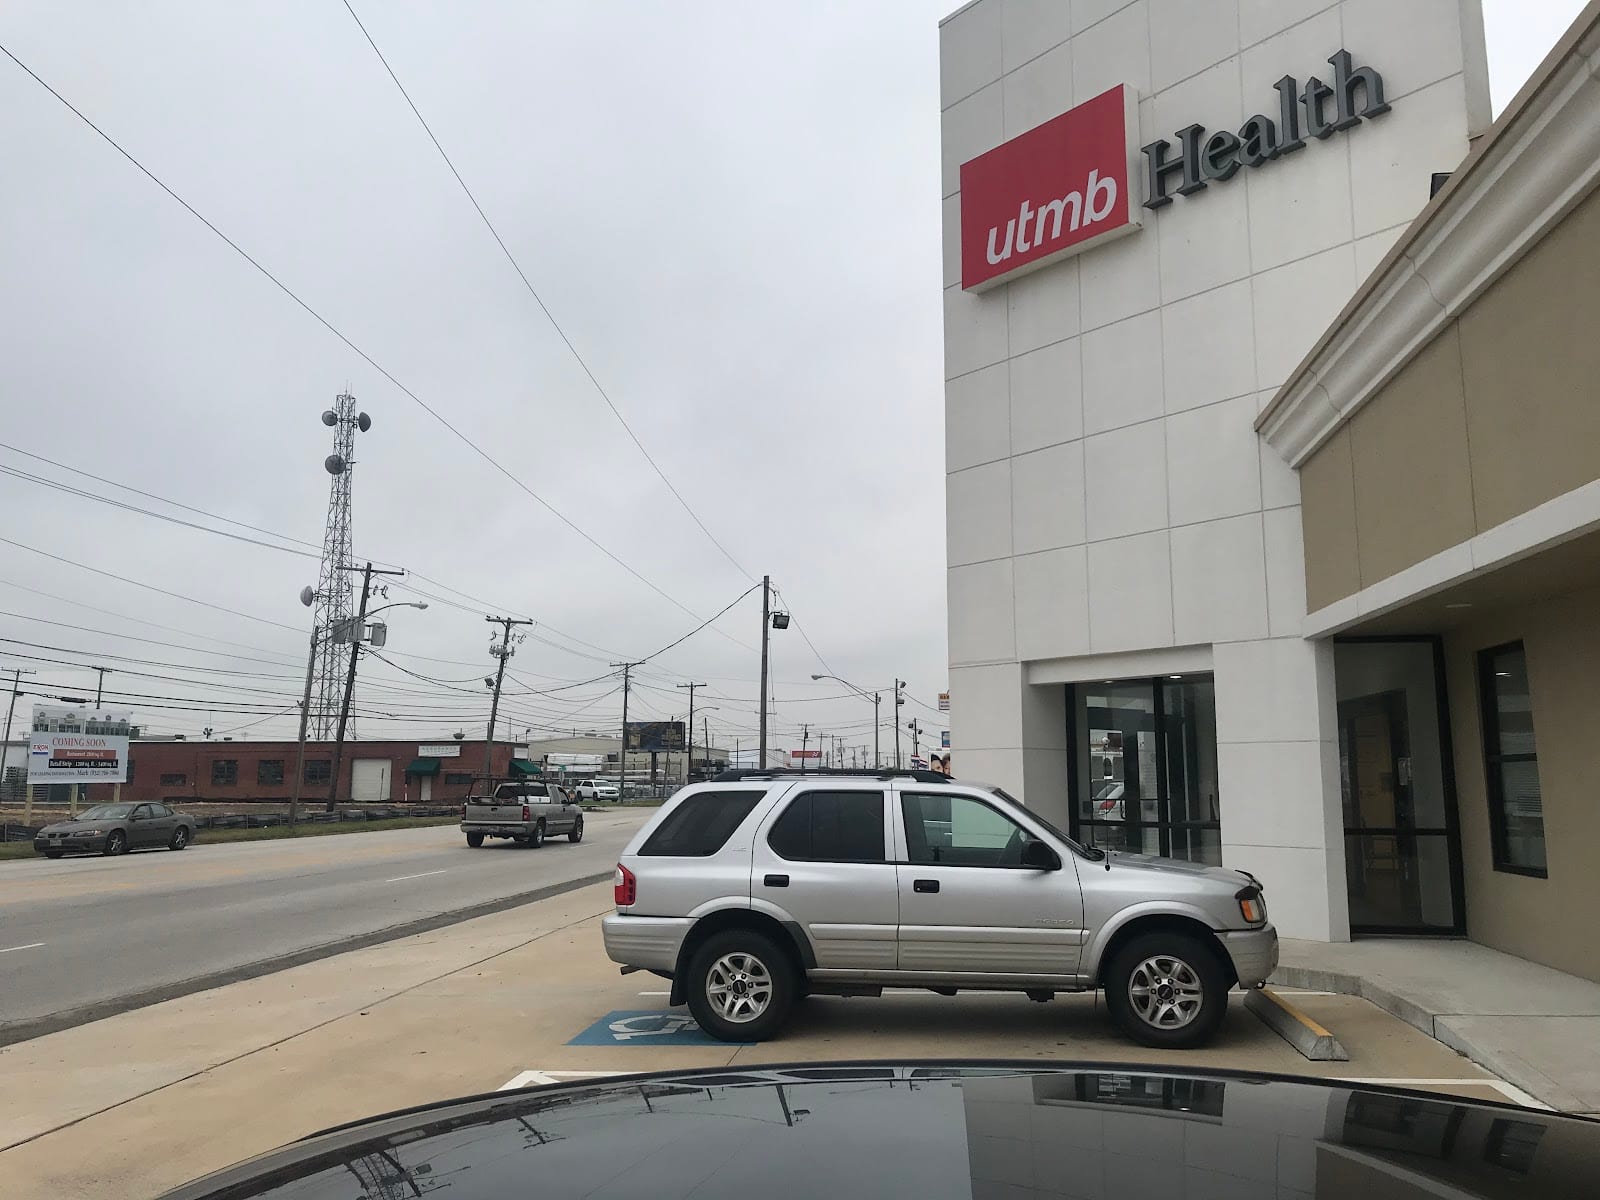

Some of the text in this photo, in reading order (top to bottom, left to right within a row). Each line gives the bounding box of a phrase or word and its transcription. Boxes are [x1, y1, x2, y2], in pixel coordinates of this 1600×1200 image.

[985, 48, 1392, 266] utmb Health
[52, 737, 106, 748] COMING SOON
